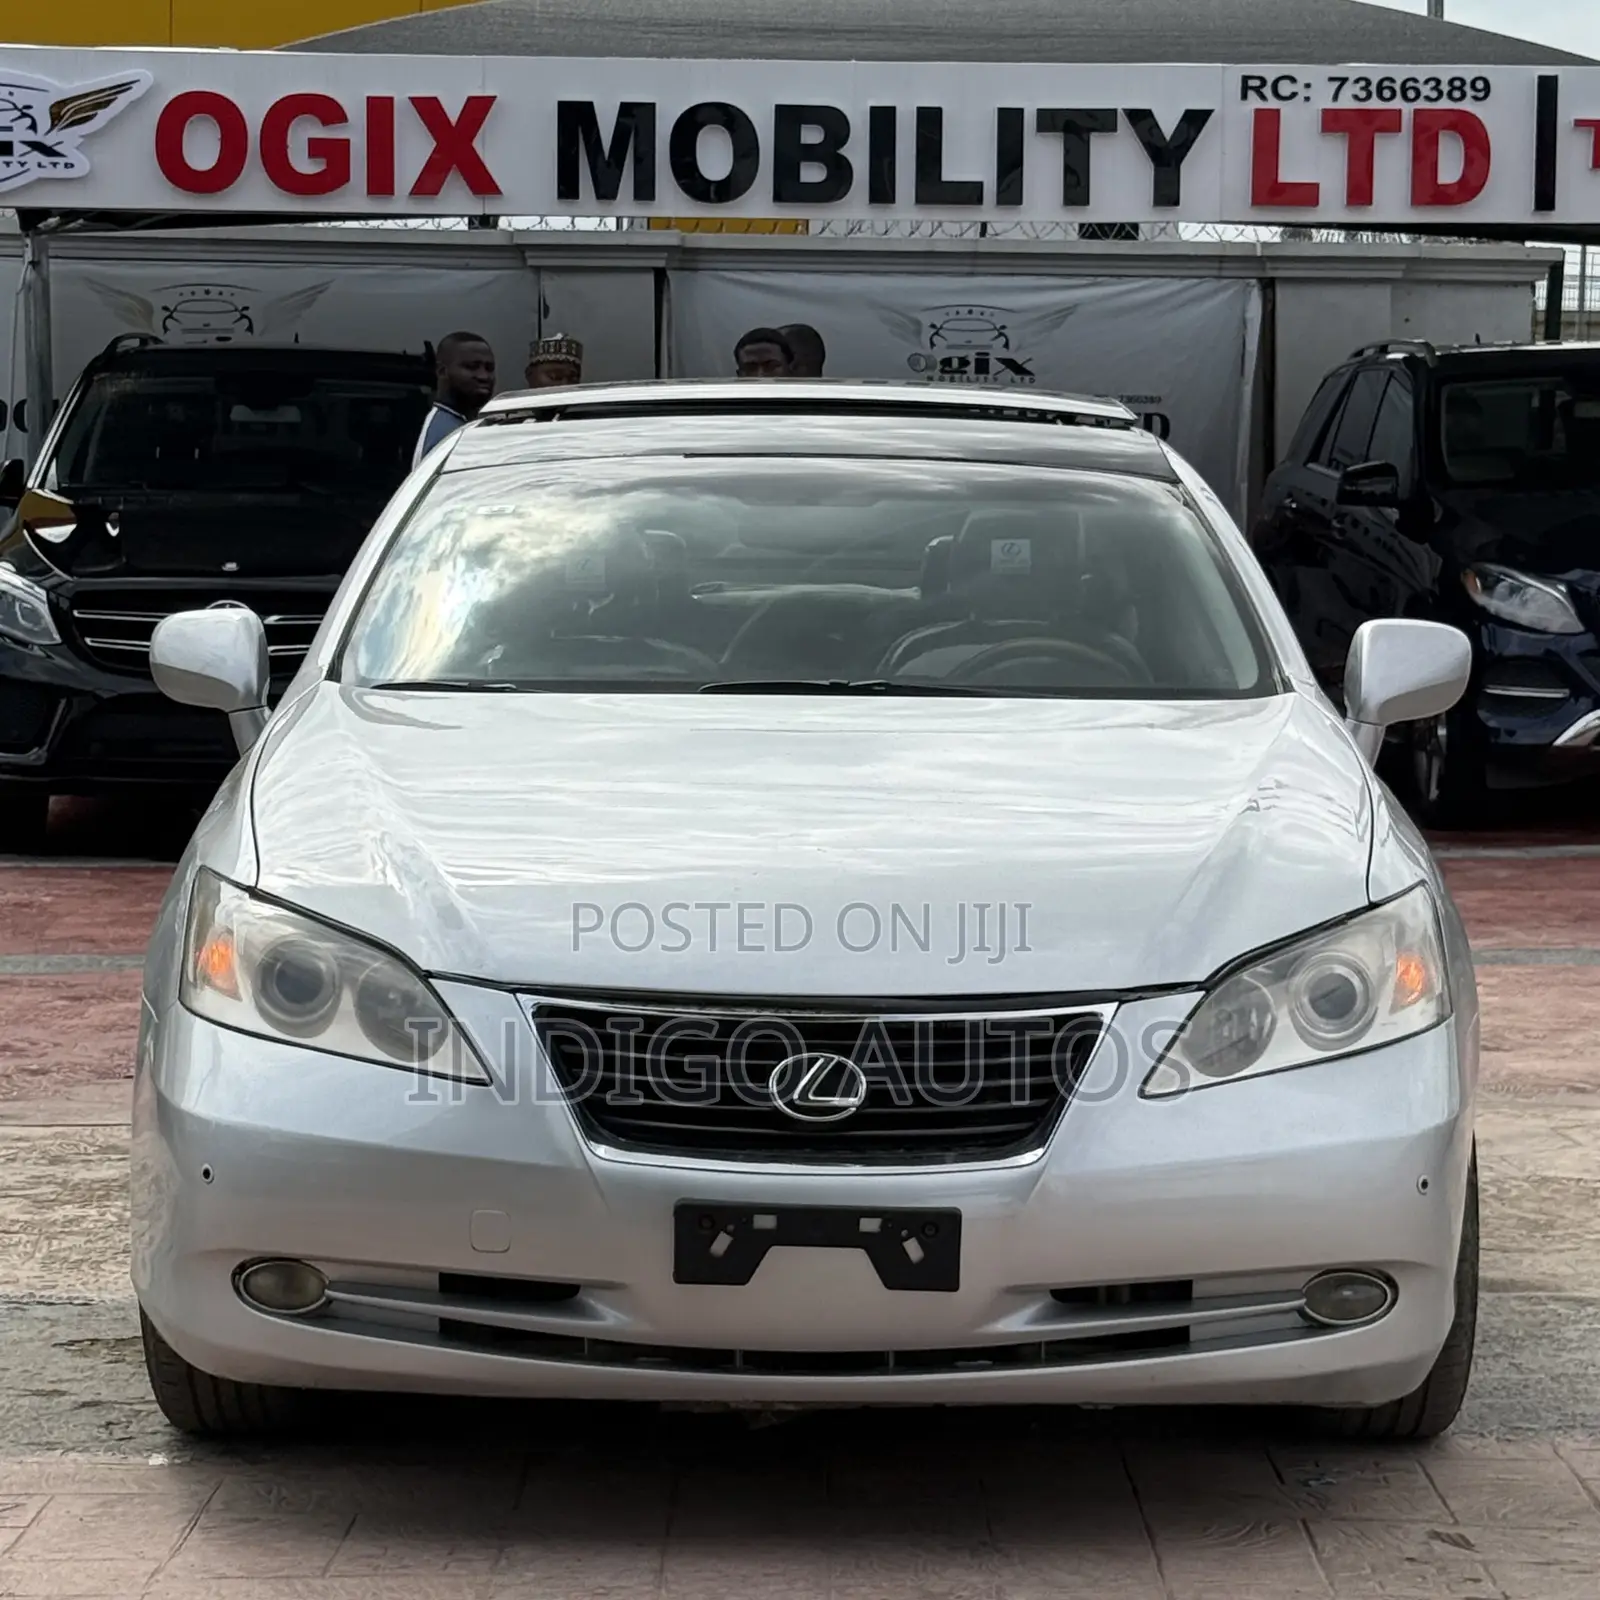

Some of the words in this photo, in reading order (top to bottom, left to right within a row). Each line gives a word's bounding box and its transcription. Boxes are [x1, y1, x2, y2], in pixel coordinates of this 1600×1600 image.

[1240, 75, 1312, 103] RC:
[1327, 76, 1492, 104] 7366389
[155, 90, 503, 196] OGIX
[557, 101, 1215, 207] MOBILITY
[1251, 108, 1491, 207] LTD
[37, 161, 75, 169] LTD
